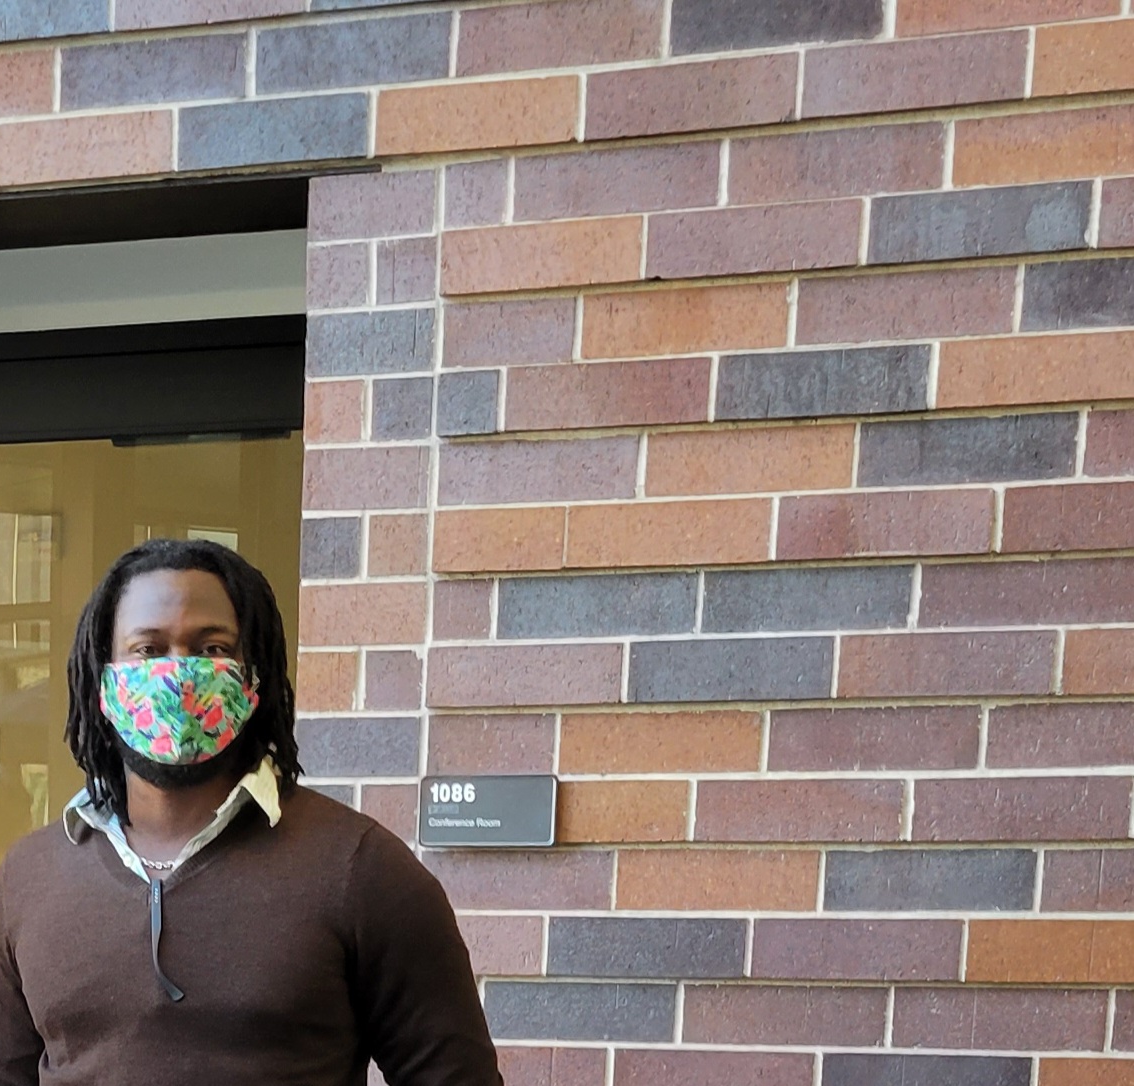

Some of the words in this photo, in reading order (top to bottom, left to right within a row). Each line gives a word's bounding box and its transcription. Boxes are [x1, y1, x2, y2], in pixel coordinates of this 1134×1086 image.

[430, 782, 476, 803] 1086
[428, 817, 475, 828] Conference
[476, 817, 501, 828] Room
